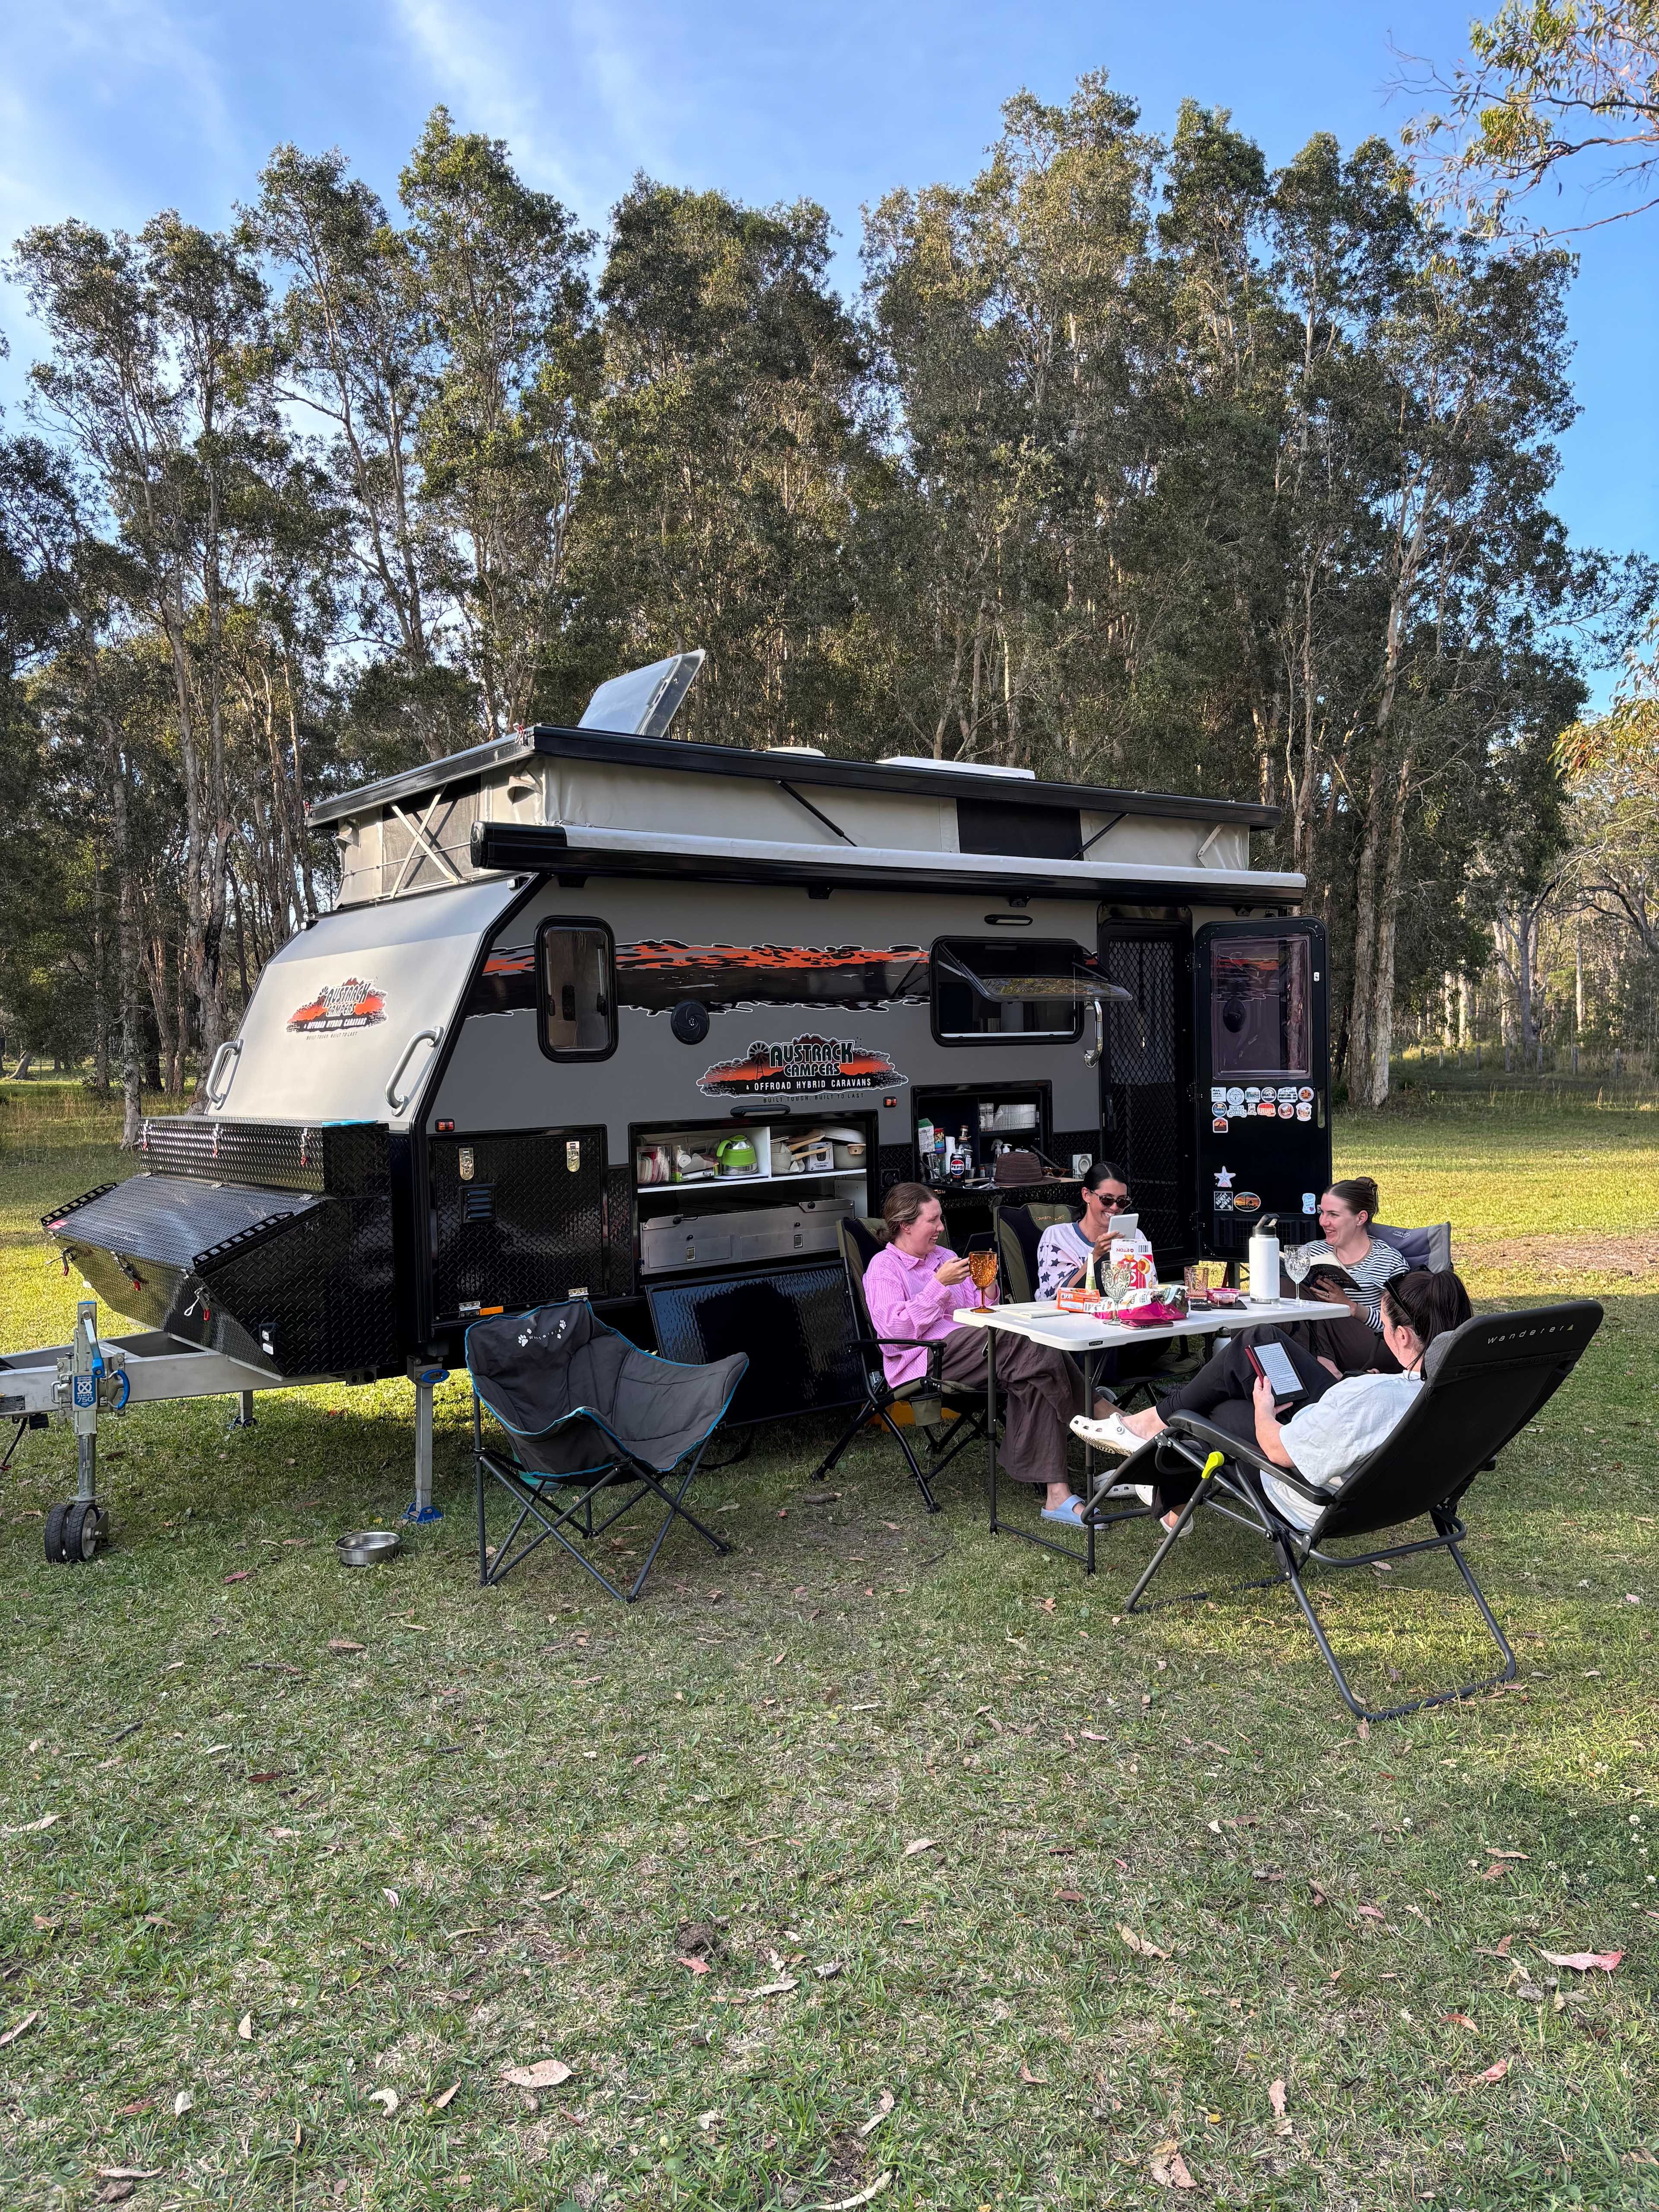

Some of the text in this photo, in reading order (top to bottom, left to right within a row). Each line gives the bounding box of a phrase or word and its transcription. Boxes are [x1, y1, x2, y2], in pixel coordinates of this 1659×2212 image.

[323, 982, 371, 1007] AUSTRACK
[327, 1003, 356, 1017] CAMPERS
[307, 1020, 326, 1030] OFFROAD
[326, 1020, 343, 1028] HYBRID
[343, 1017, 367, 1027] CARAVANS
[770, 1042, 854, 1068] AUSTRACK
[784, 1062, 841, 1077] CAMPERS
[754, 1081, 791, 1091] OFFROAD
[796, 1080, 826, 1089] HYBRID
[831, 1078, 871, 1087] CARAVANS
